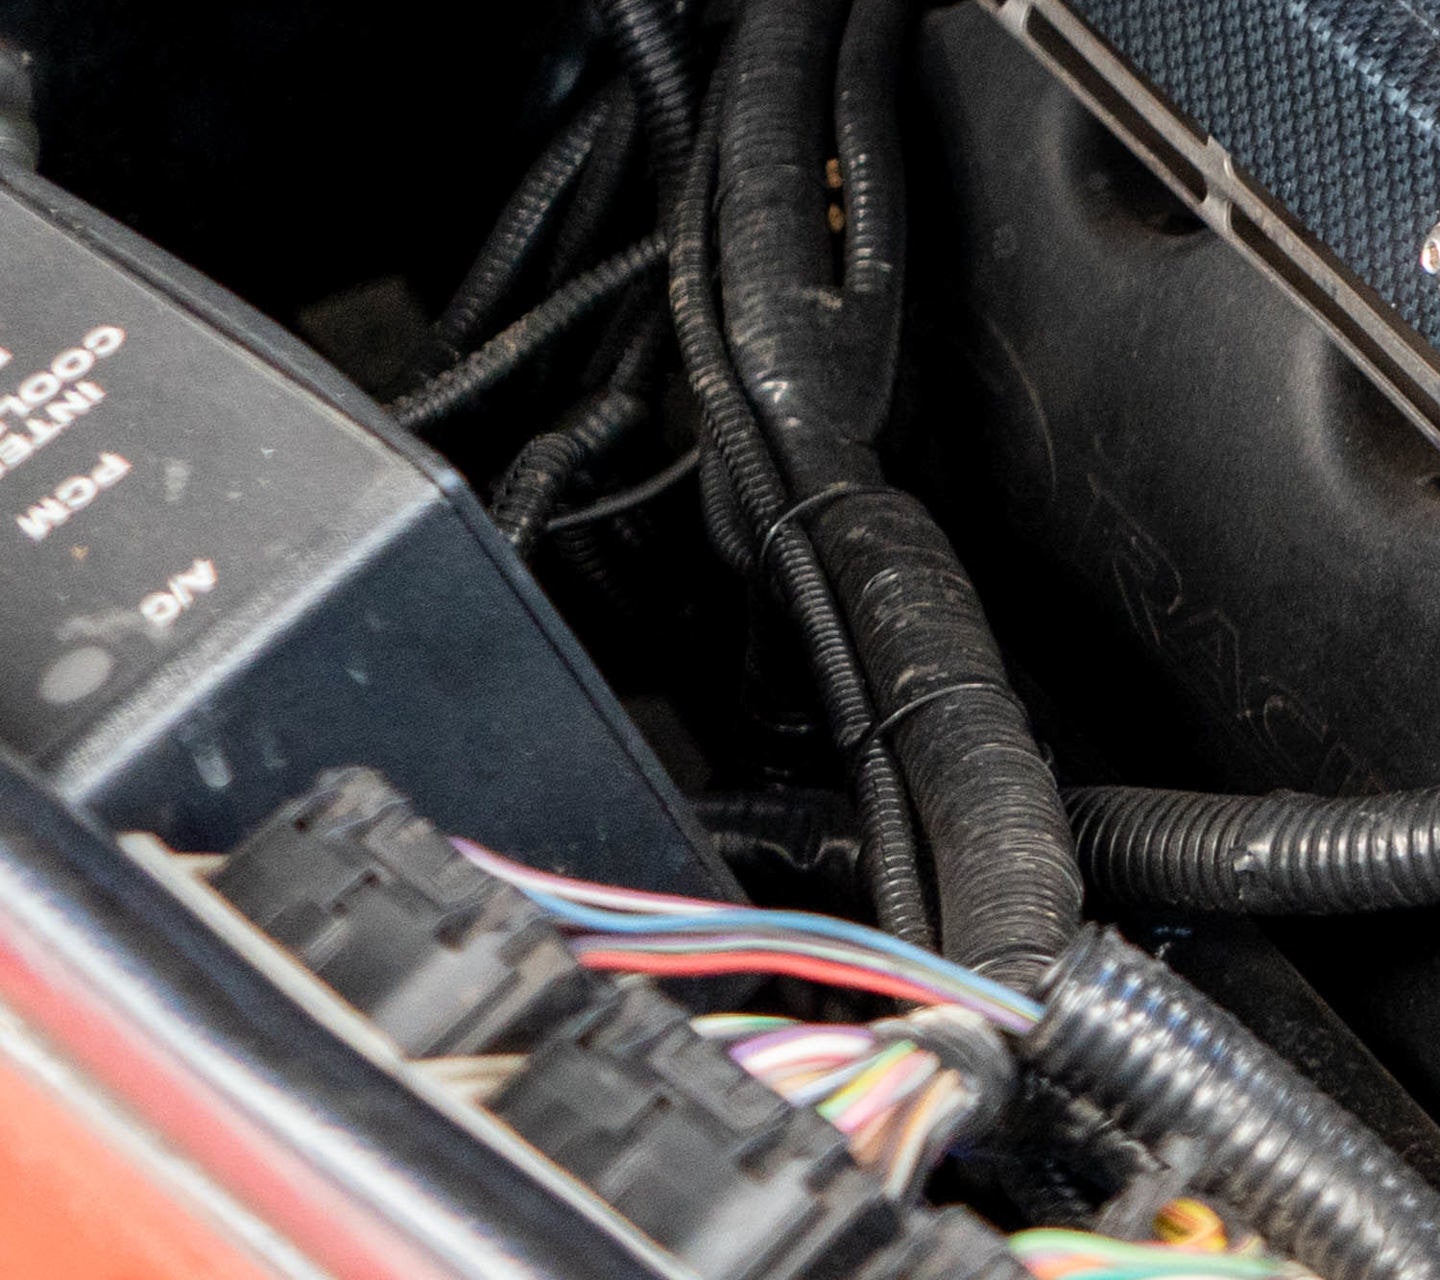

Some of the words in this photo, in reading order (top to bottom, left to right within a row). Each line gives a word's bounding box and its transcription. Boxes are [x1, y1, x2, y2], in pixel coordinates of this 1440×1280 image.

[0, 325, 125, 433] COOL
[0, 381, 106, 479] INTE
[16, 451, 132, 541] PCM
